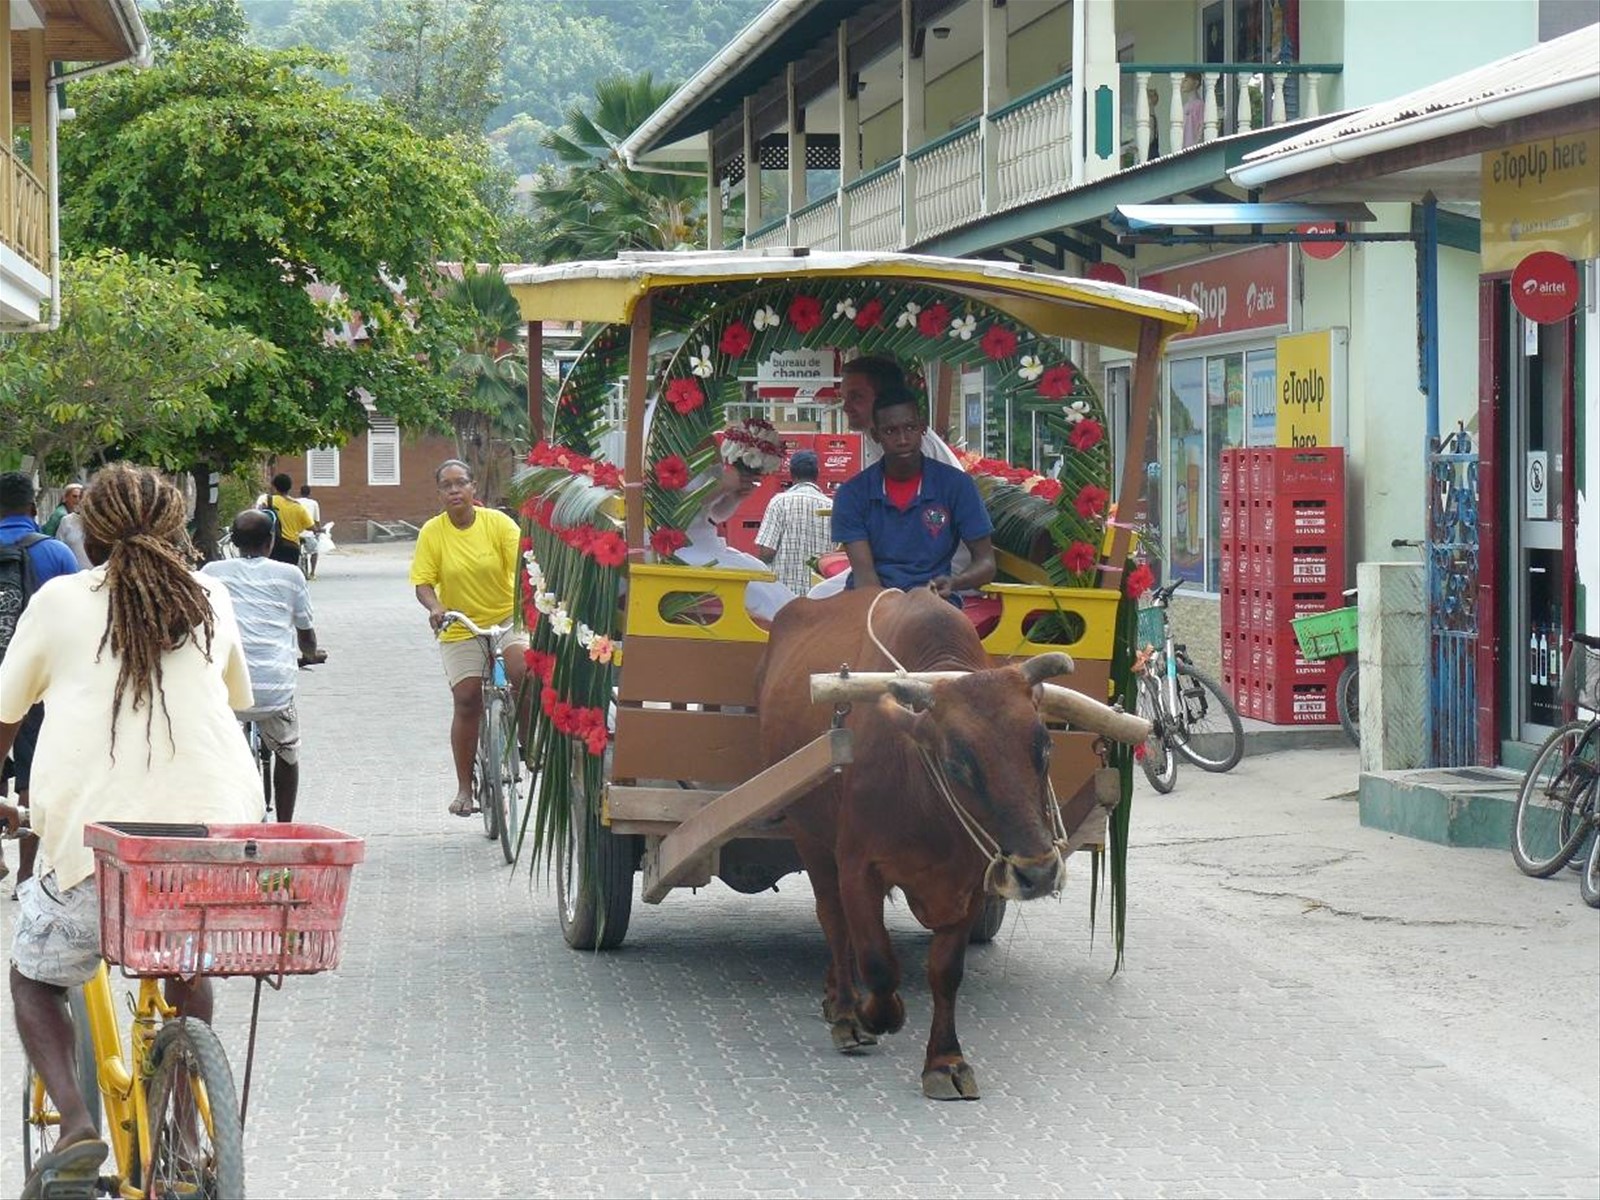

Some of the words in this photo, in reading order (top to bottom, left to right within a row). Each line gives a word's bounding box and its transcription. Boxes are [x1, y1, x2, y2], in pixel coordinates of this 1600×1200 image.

[1493, 144, 1548, 188] eTopUp
[1552, 136, 1587, 171] here
[1256, 286, 1275, 311] airtel
[1540, 282, 1565, 292] airtel
[1191, 281, 1227, 328] Shop
[772, 358, 806, 367] bureau
[808, 358, 821, 367] de
[772, 368, 821, 378] change
[1283, 368, 1324, 414] eTopUp
